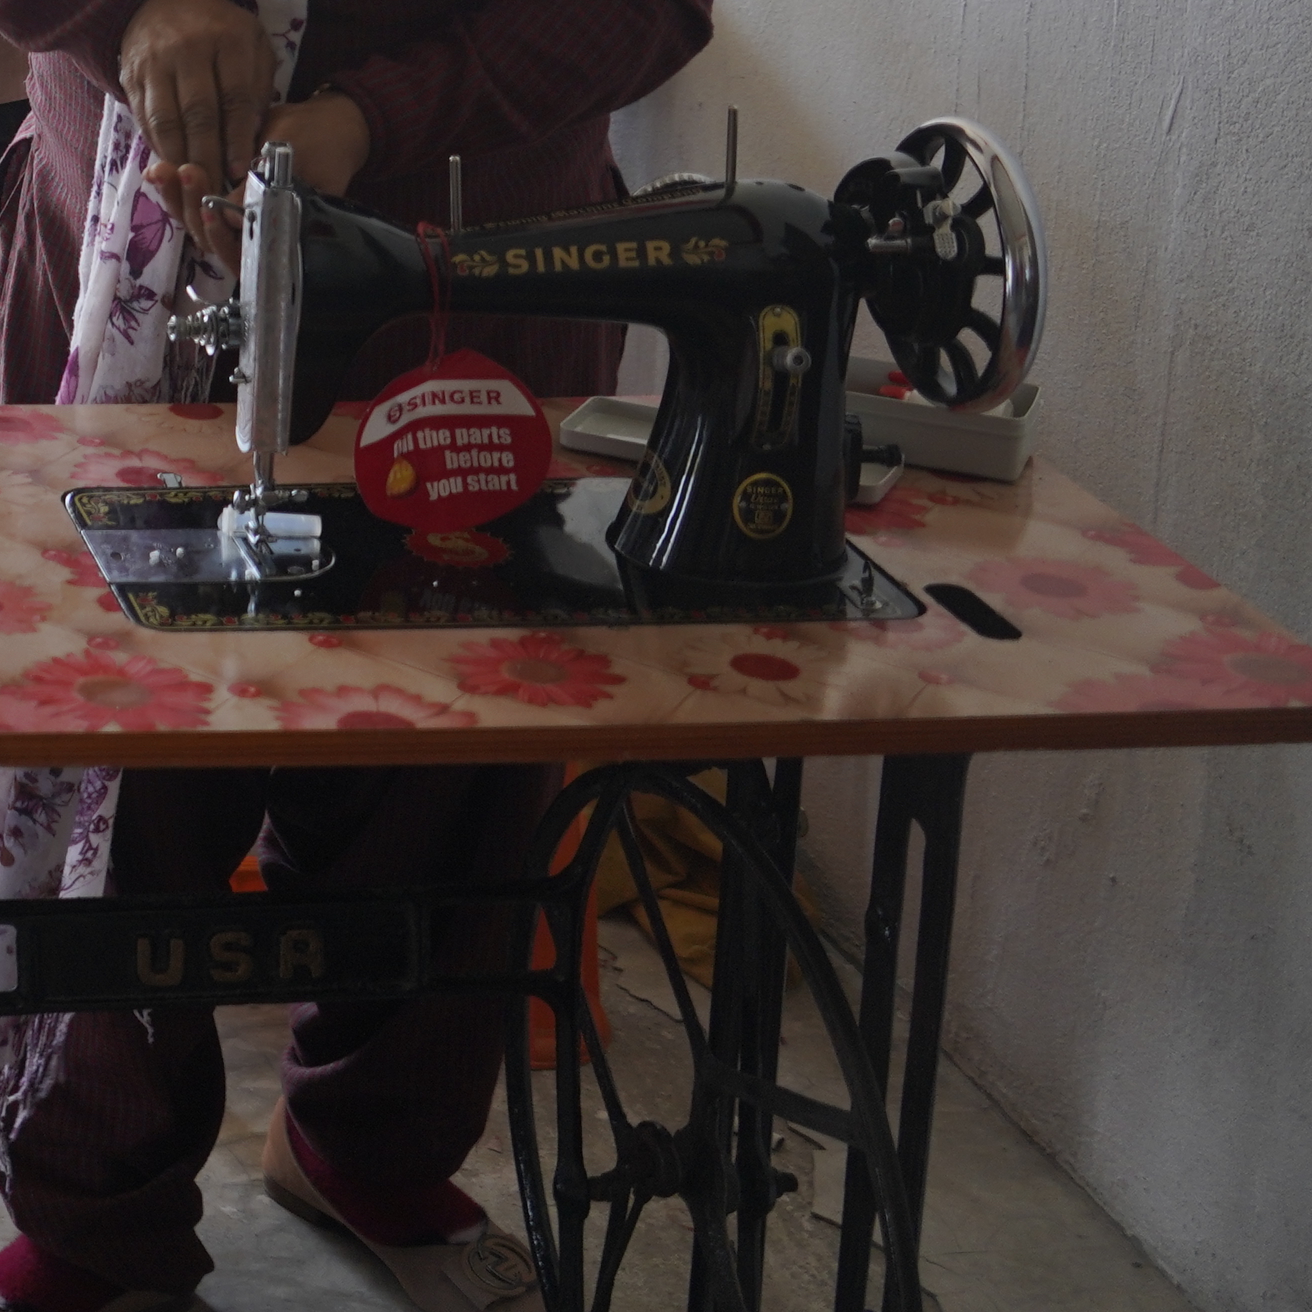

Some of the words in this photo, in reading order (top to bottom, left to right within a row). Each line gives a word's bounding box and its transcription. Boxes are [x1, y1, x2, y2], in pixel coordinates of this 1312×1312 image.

[506, 239, 674, 275] SINGER
[407, 389, 502, 413] SINGER
[417, 427, 452, 450] the
[455, 425, 512, 447] parts
[444, 449, 515, 471] before
[425, 476, 464, 502] you
[466, 472, 519, 492] start
[136, 928, 325, 987] USA
